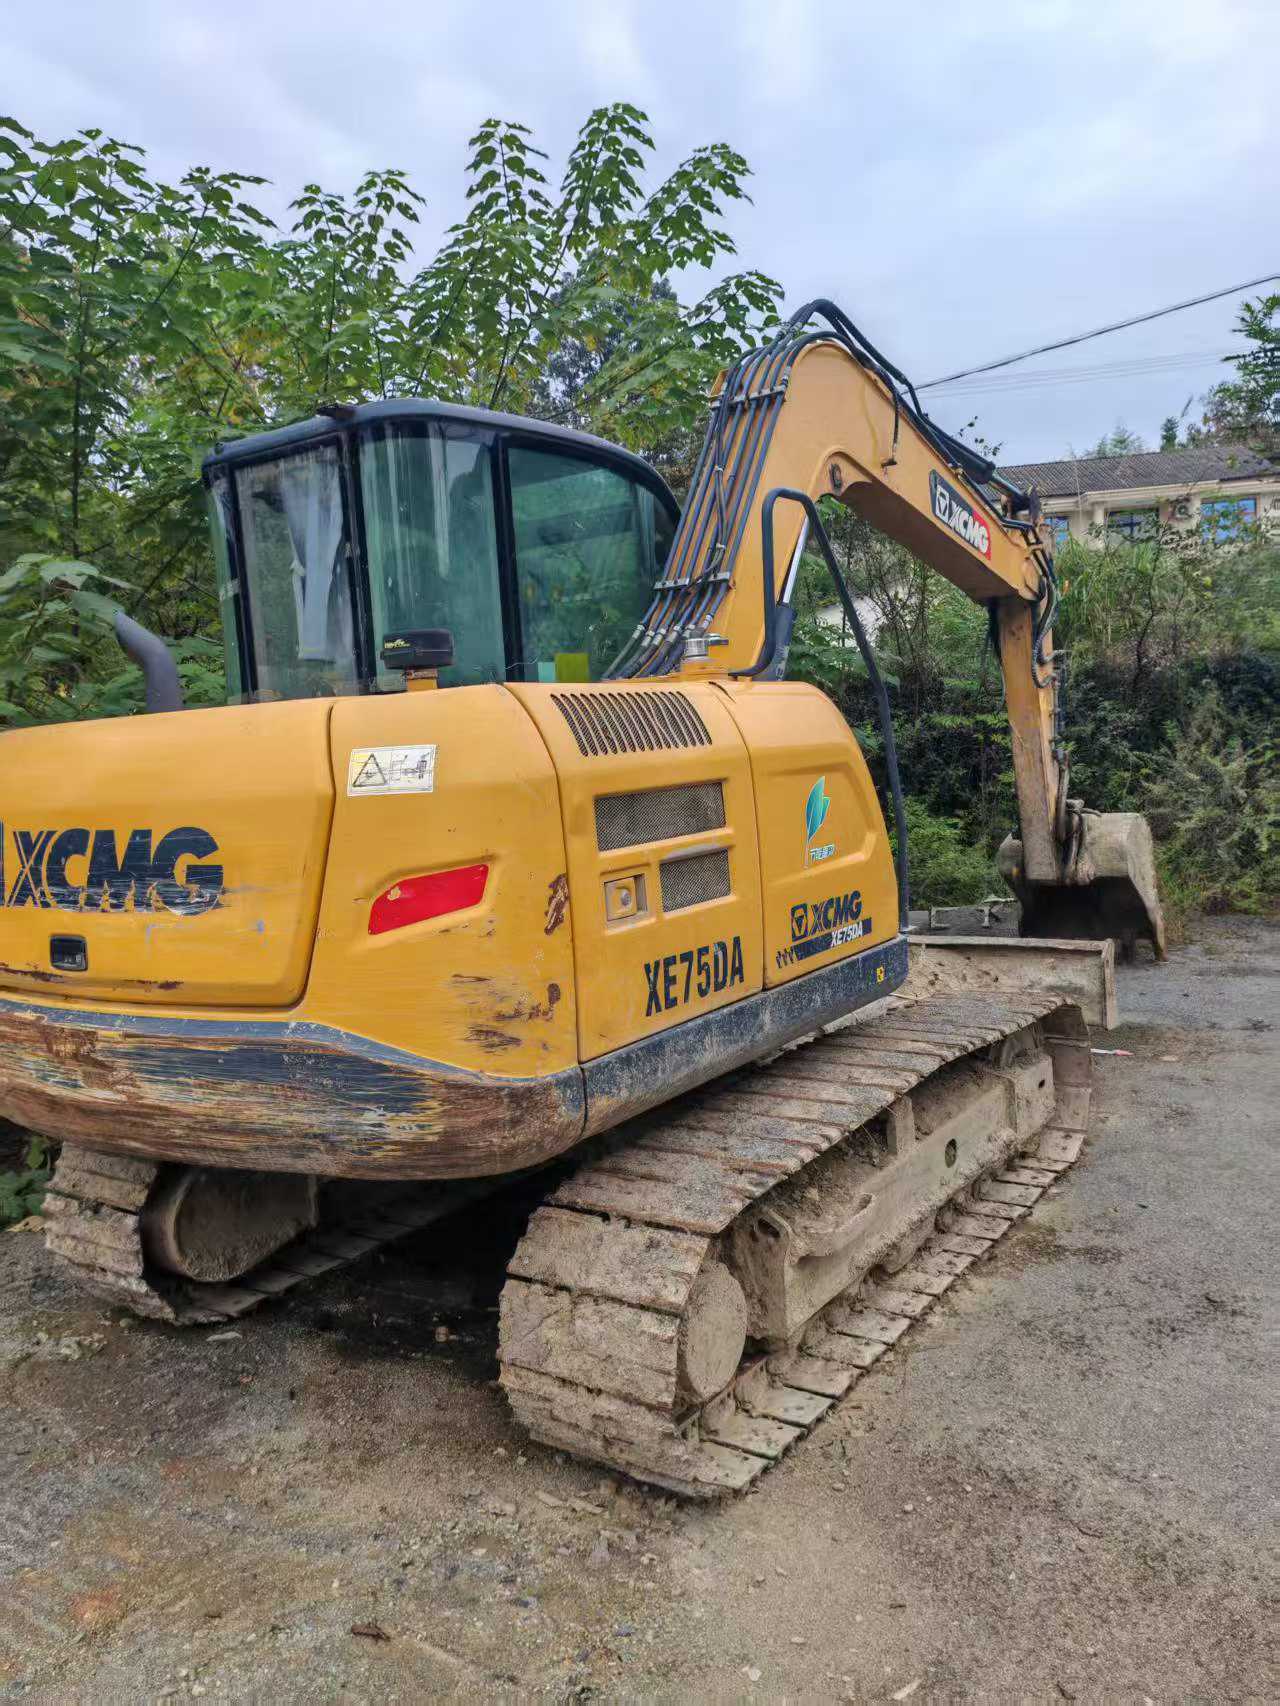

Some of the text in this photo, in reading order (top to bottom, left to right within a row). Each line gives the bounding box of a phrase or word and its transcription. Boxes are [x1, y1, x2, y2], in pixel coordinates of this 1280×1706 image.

[948, 500, 988, 554] XCMG
[8, 827, 224, 916] XCMG
[809, 890, 862, 936] XCMG
[831, 920, 863, 947] XE75DA
[644, 936, 745, 1017] XE75DA
